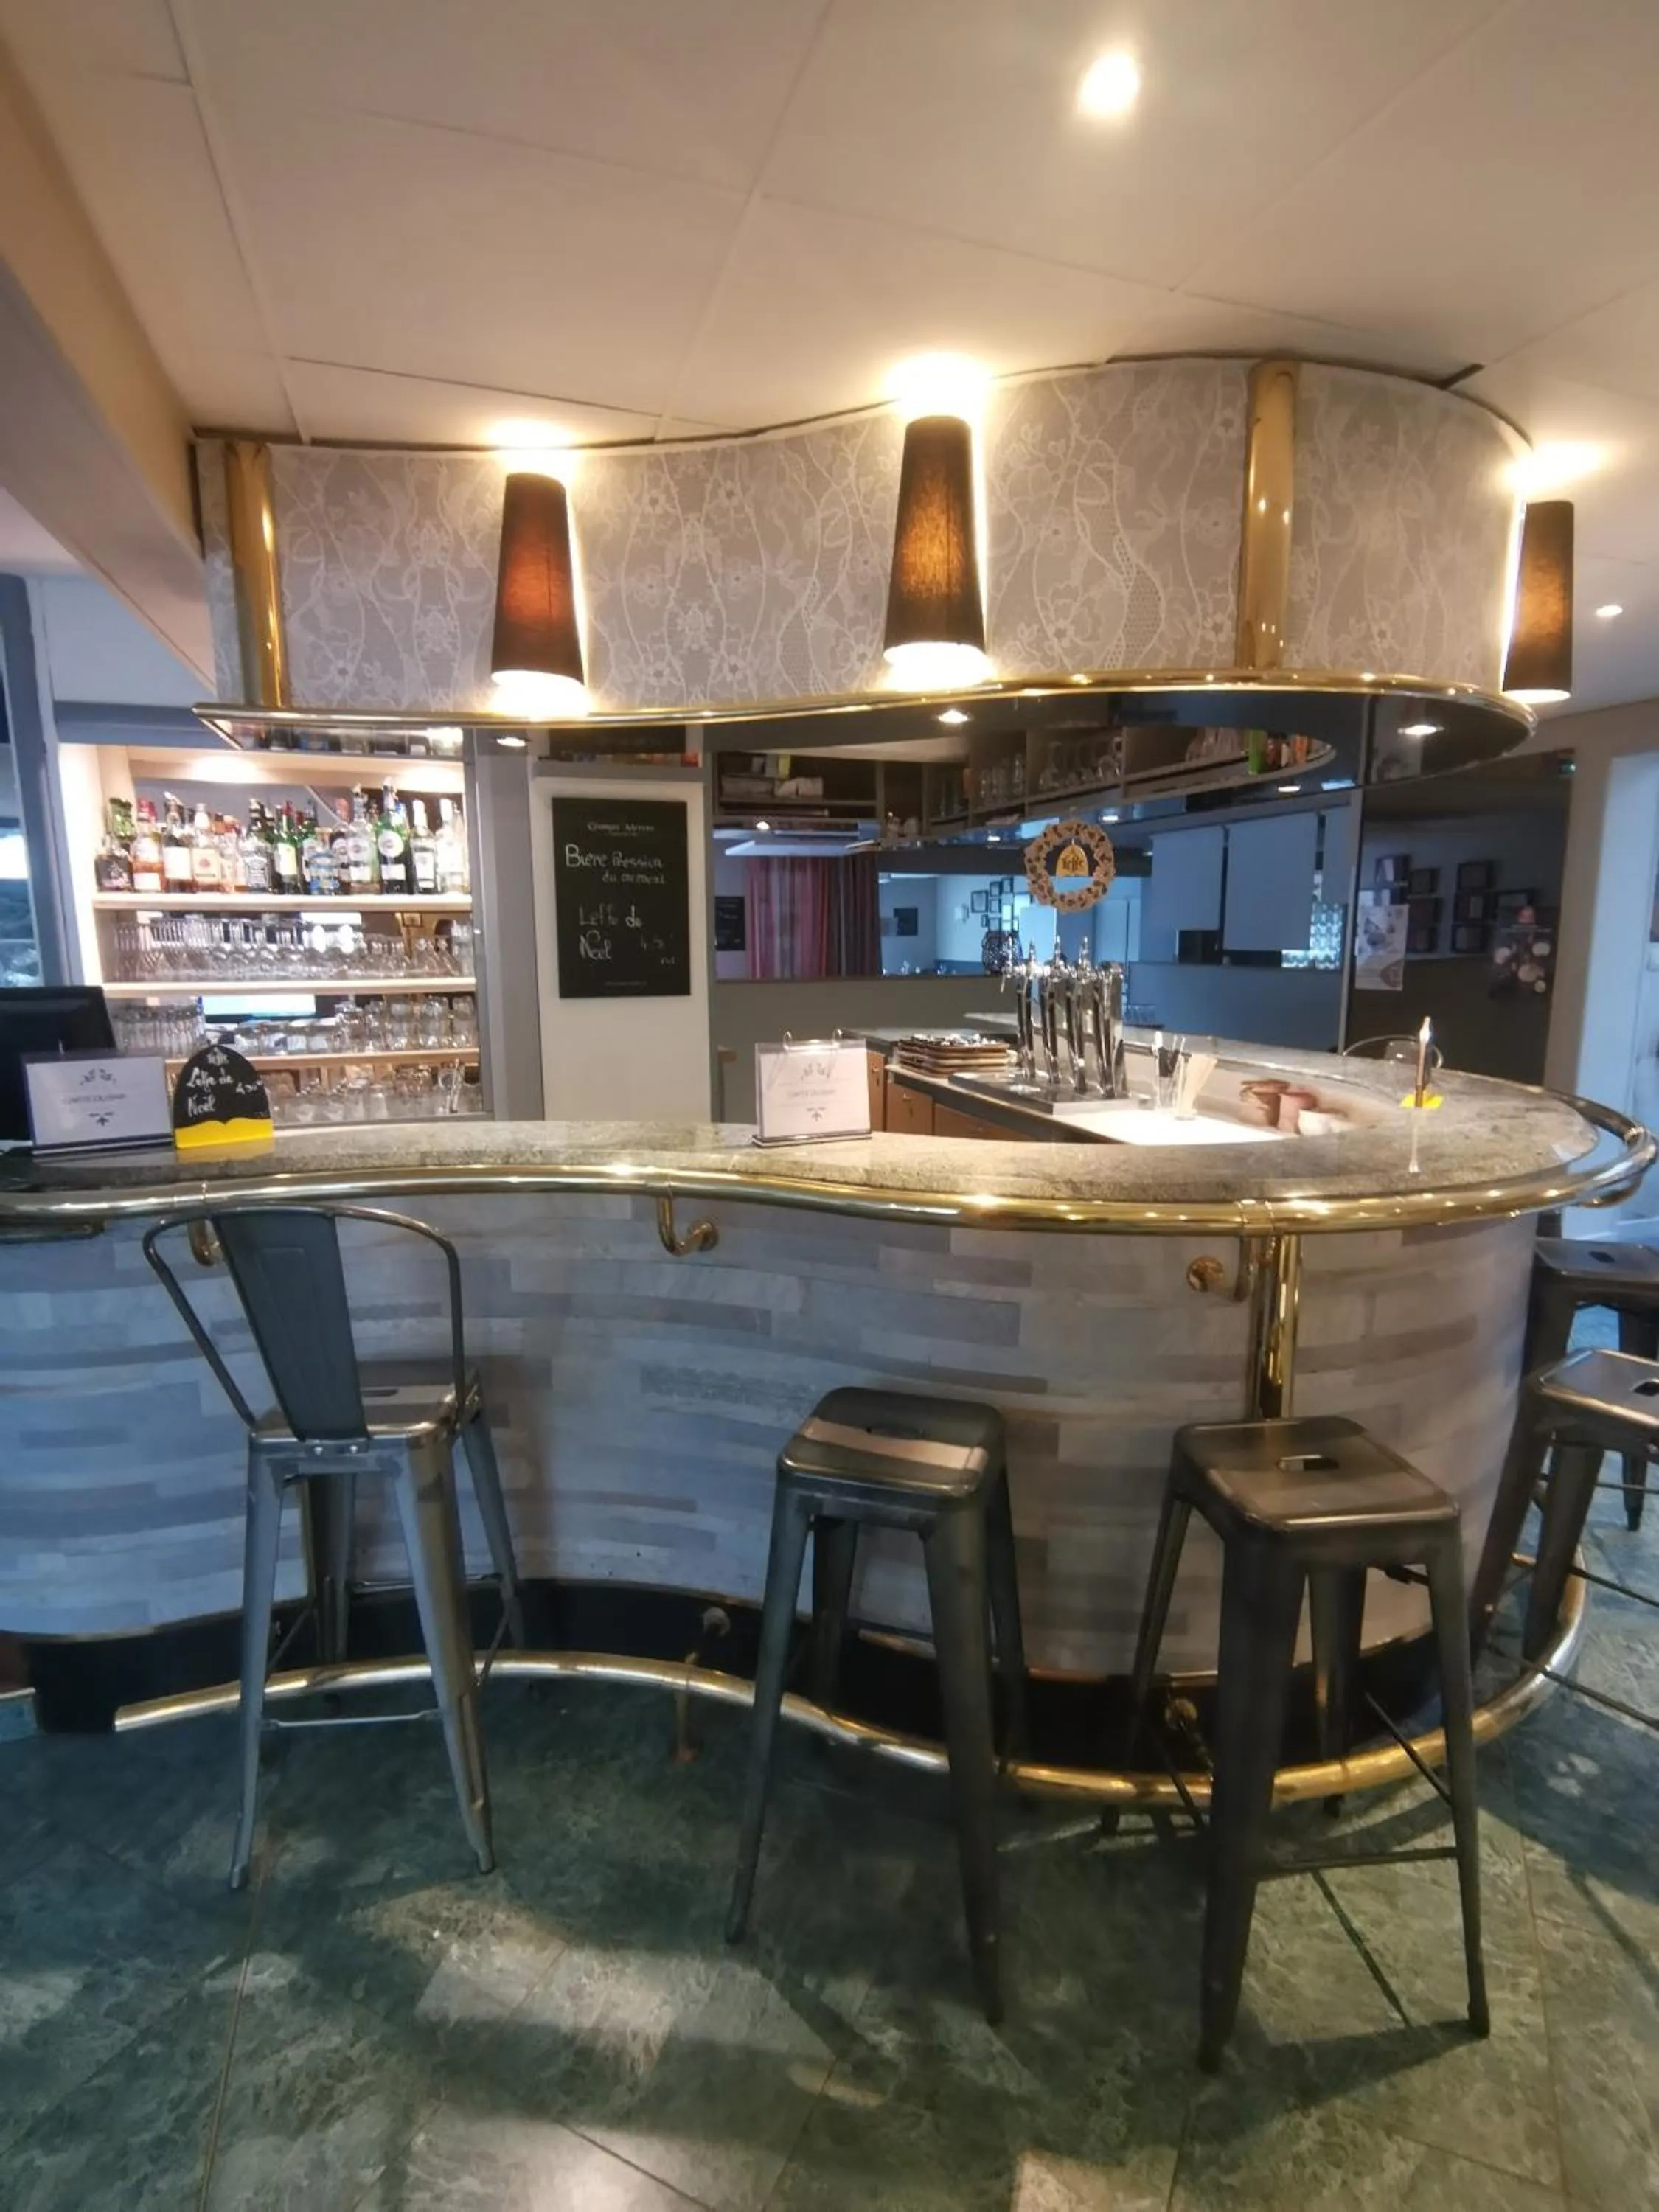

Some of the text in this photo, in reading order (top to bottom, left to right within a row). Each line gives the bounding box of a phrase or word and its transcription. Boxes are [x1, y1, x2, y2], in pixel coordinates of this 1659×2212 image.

[579, 902, 642, 928] Leffe de
[186, 1066, 217, 1093] Leffe
